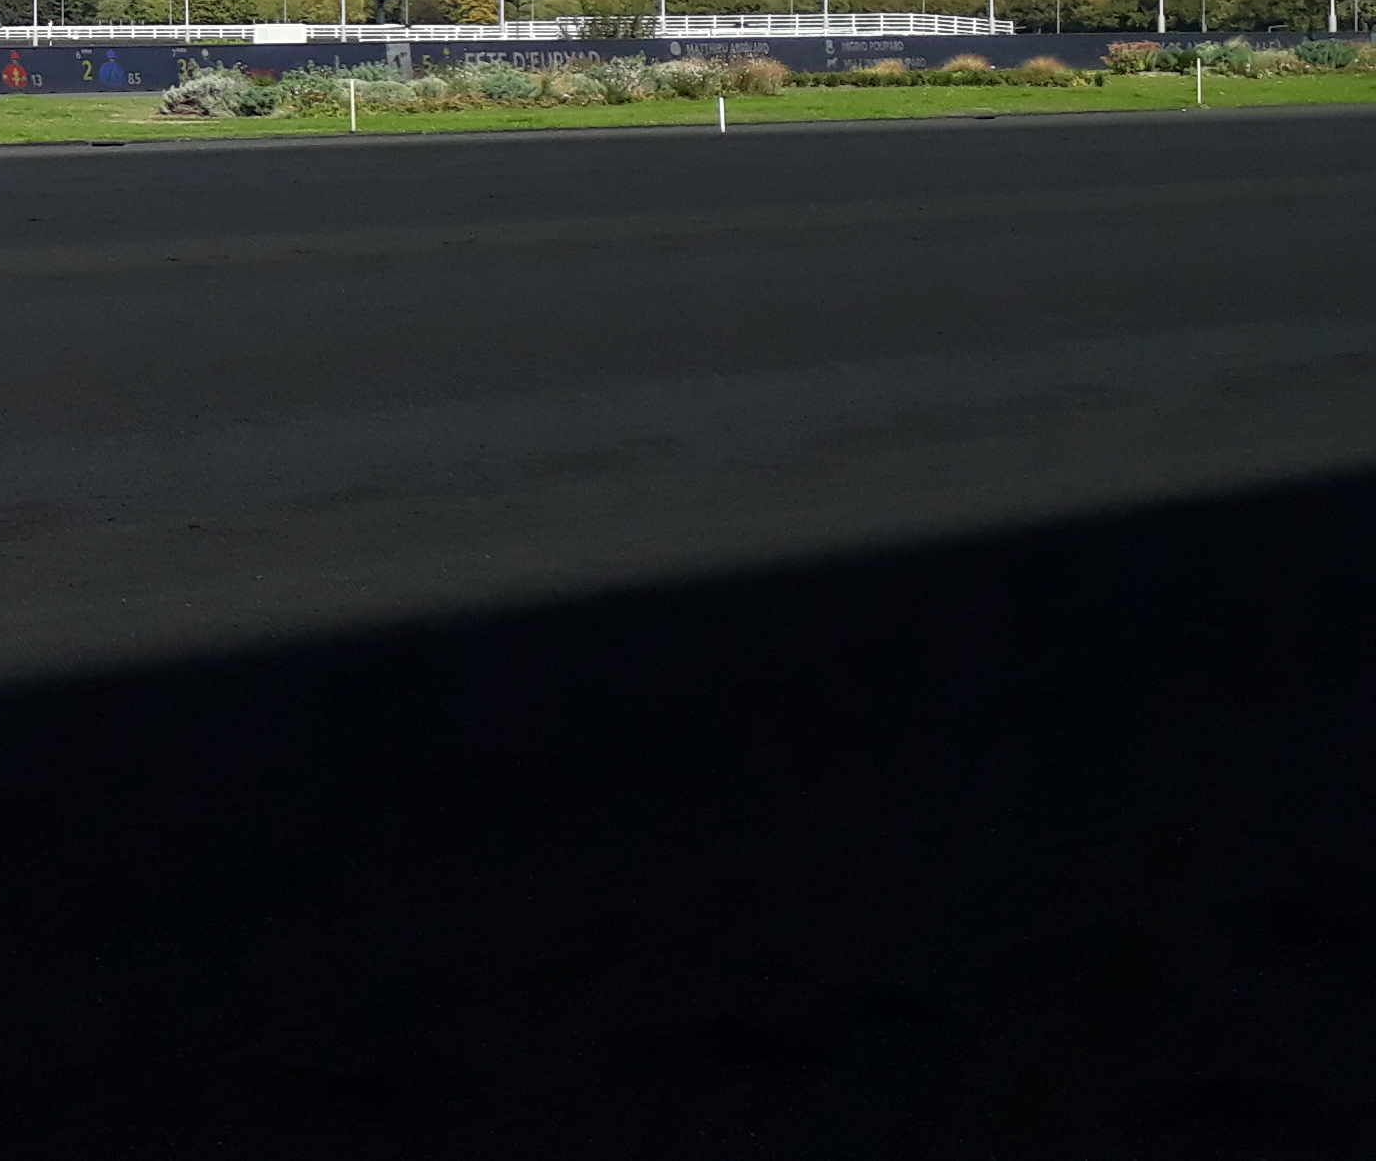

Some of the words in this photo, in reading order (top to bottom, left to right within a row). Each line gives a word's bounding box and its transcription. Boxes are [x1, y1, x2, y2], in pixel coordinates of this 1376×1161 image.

[82, 60, 94, 81] 2
[31, 74, 43, 87] 13
[127, 73, 142, 86] 85
